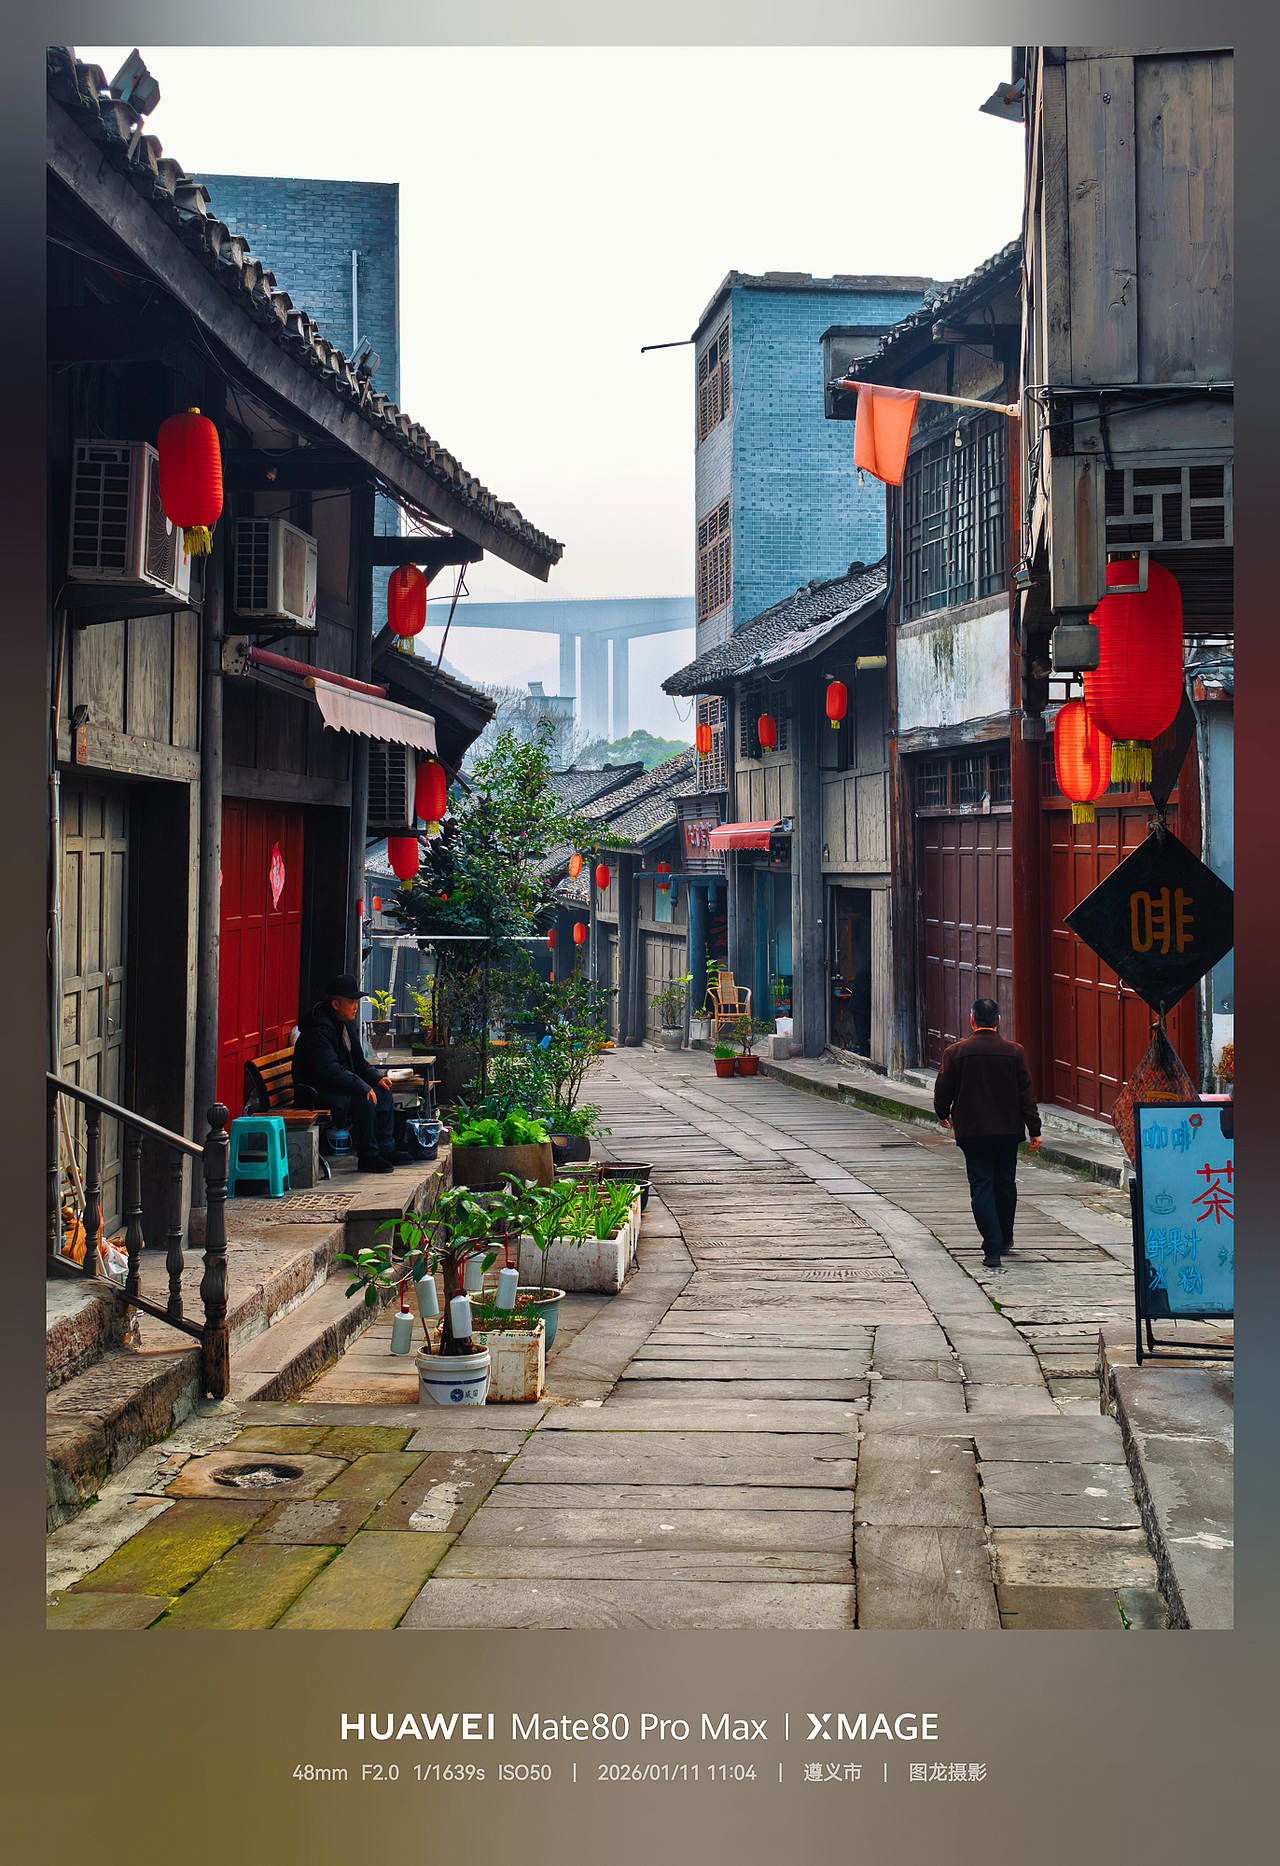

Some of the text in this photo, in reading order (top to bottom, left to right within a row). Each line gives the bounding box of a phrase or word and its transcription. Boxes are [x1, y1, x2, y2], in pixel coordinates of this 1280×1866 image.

[1130, 886, 1194, 955] 啡
[1142, 1120, 1192, 1154] 咖啡
[1190, 1160, 1234, 1226] 茶
[1146, 1227, 1202, 1265] 鲜果汁
[1148, 1265, 1204, 1295] 冰粉
